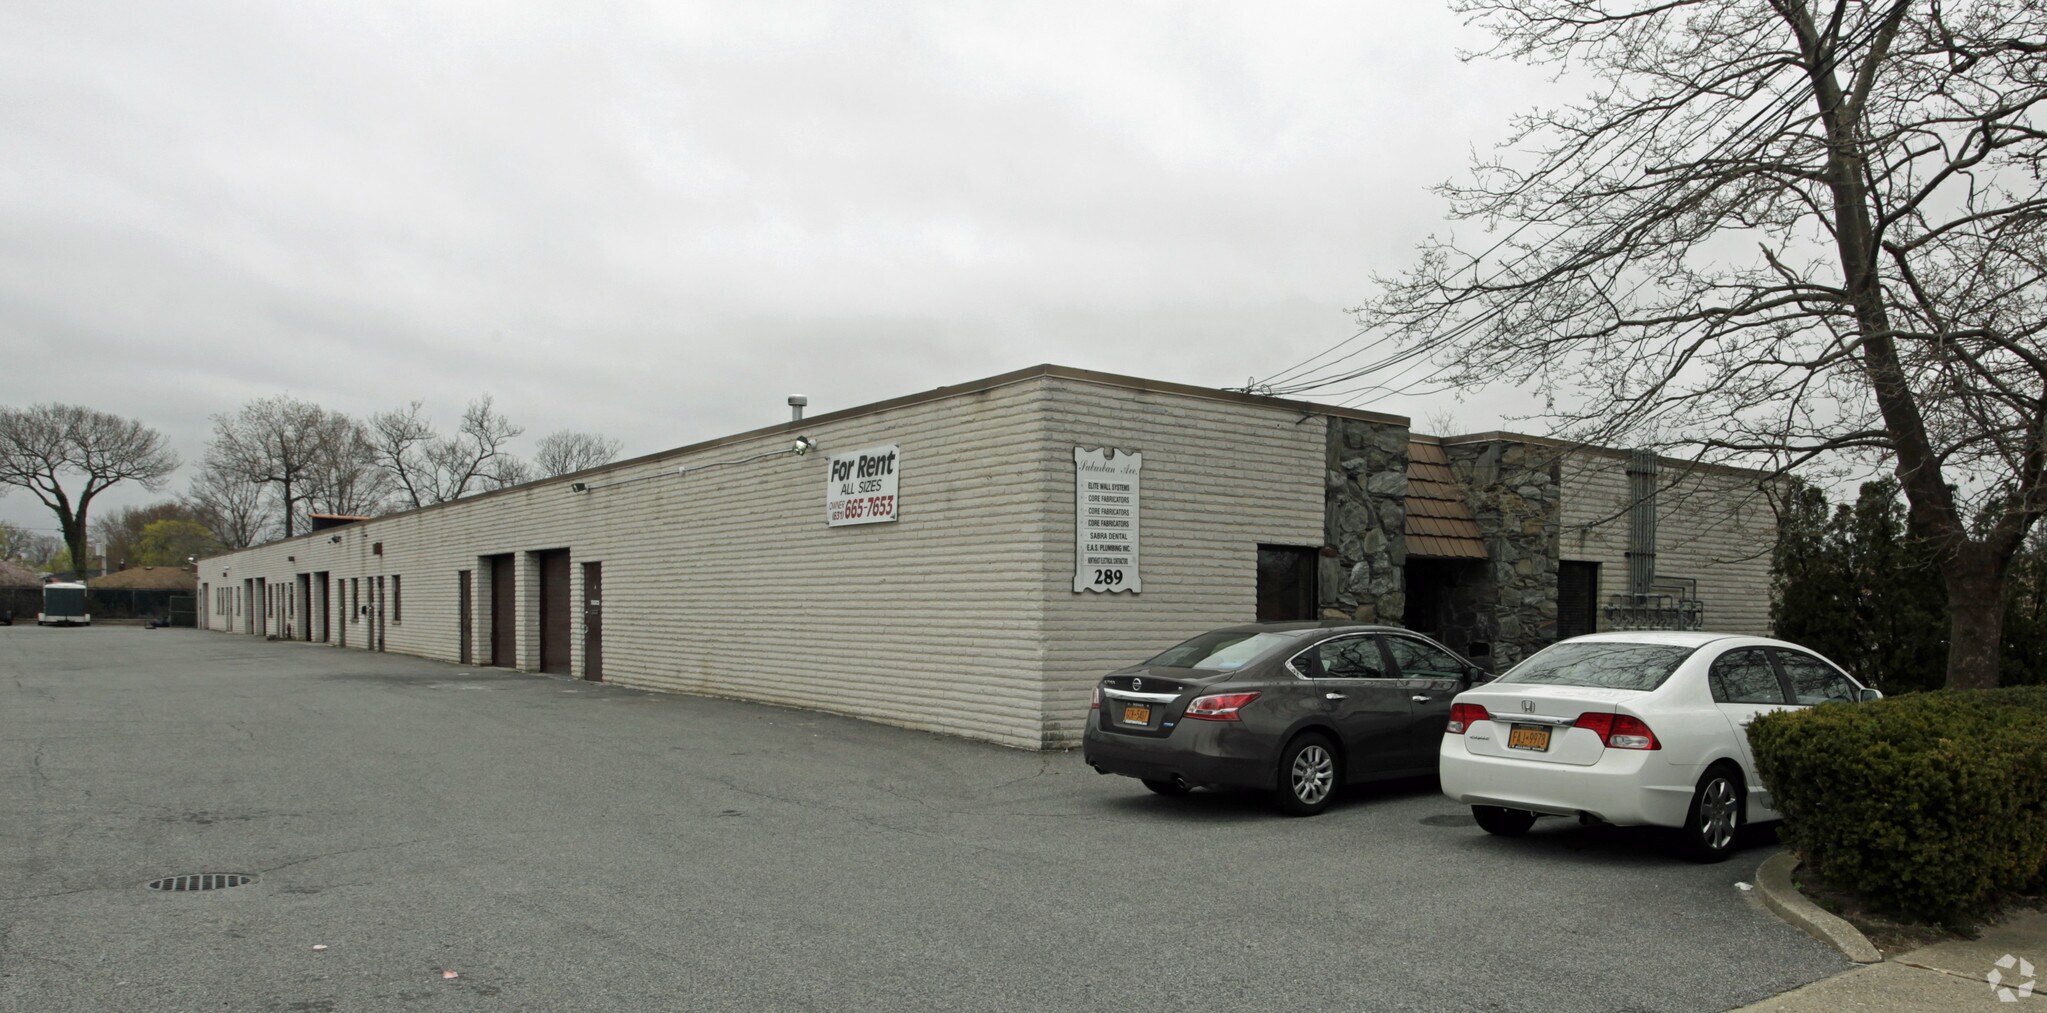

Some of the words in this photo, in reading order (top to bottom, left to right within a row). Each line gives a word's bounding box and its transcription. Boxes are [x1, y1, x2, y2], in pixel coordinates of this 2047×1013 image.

[831, 459, 855, 483] For
[856, 450, 896, 479] Rent
[840, 482, 855, 496] ALL
[858, 479, 882, 494] SIZES
[1087, 481, 1099, 490] ELITE
[1111, 483, 1130, 492] SYSTEMS
[1088, 494, 1100, 503] CORE
[1101, 495, 1130, 504] FABRICATORS
[829, 500, 846, 511] OWNER
[845, 495, 894, 520] 665-7653
[1088, 507, 1100, 515] CORE
[1101, 507, 1130, 517] FABRICATORS
[1087, 519, 1100, 527] CORE
[1101, 519, 1130, 528] FABRICATORS
[1090, 532, 1108, 540] SABRA
[1108, 532, 1128, 540] DENTAL
[1100, 544, 1122, 552] PLUMBING
[1094, 569, 1124, 586] 289
